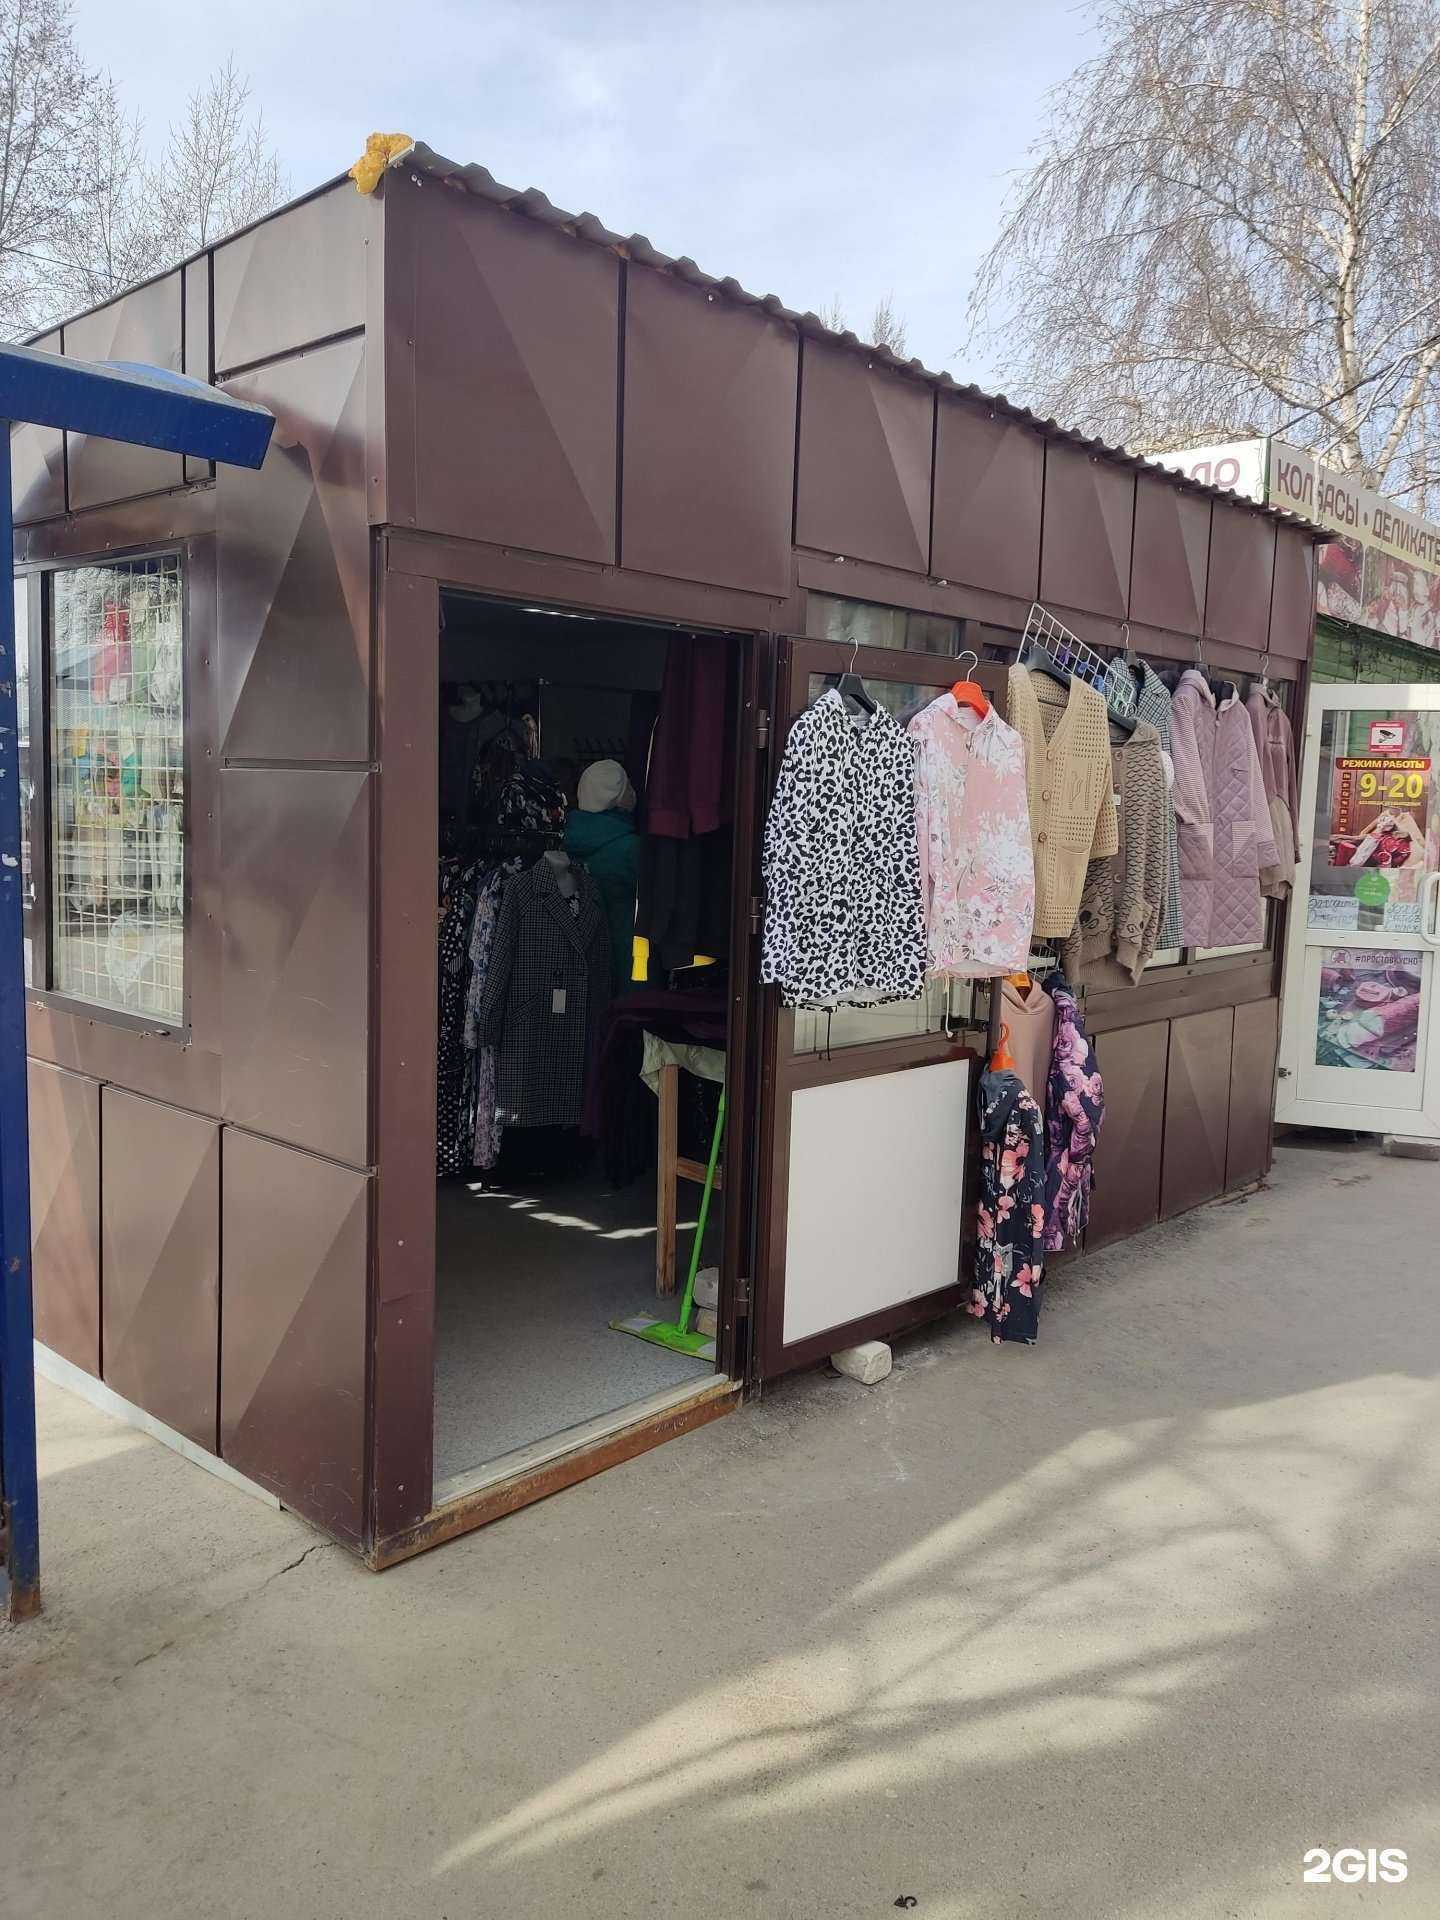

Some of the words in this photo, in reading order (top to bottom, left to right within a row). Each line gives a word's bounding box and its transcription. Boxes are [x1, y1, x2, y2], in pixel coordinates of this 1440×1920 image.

[1342, 759, 1382, 768] РЕЖИМ
[1382, 760, 1425, 769] РАБОТЫ
[1359, 773, 1424, 799] 9-20
